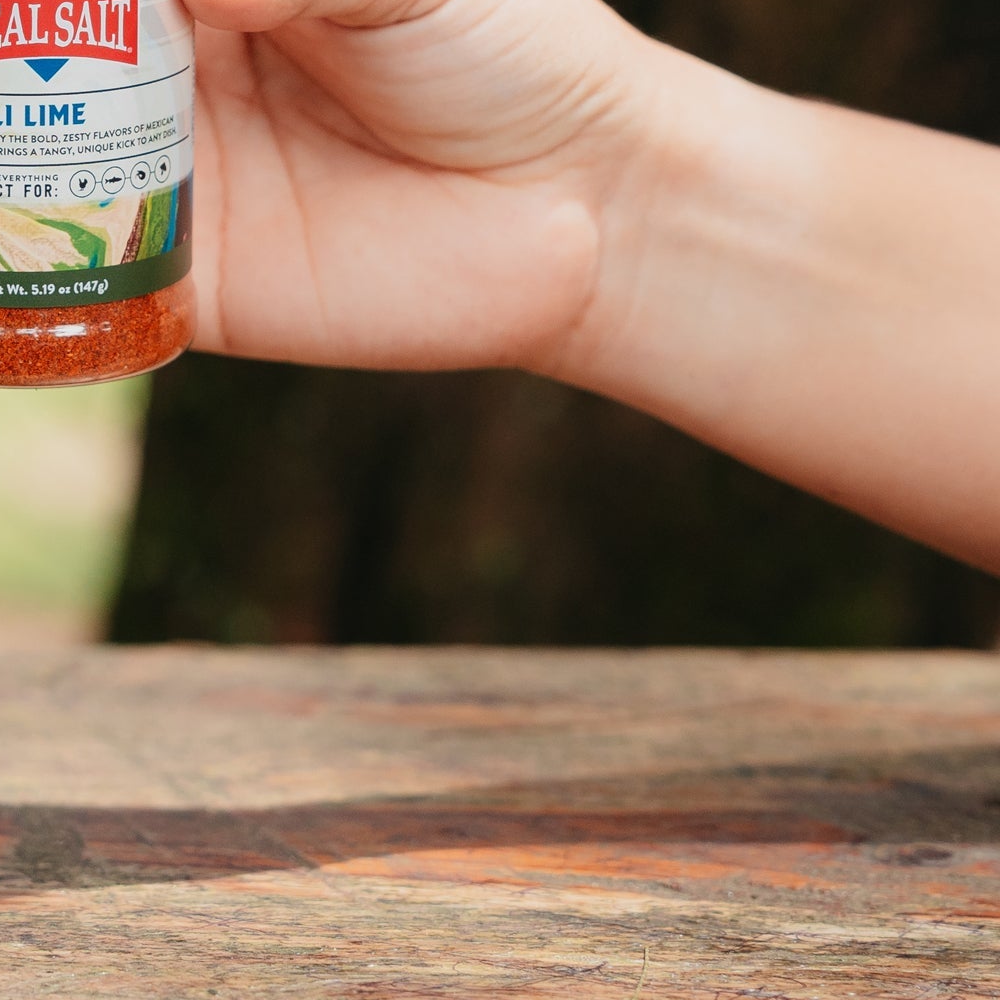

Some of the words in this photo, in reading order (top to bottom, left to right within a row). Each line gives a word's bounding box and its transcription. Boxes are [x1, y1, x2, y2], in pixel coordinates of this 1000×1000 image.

[24, 102, 86, 127] LIME
[9, 134, 28, 144] THE
[31, 134, 61, 144] BOLD,
[63, 132, 91, 142] ZESTY
[93, 126, 132, 140] FLAVORS
[133, 124, 145, 134] OF
[146, 115, 174, 131] MEXICAN
[30, 148, 38, 156] A
[40, 146, 75, 156] TANGY,
[77, 142, 114, 154] UNIQUE
[116, 138, 136, 149] KICK
[137, 136, 147, 145] TO
[148, 133, 161, 143] ANY
[24, 184, 59, 198] FOR:
[6, 284, 28, 295] Wt.
[31, 284, 55, 295] 5.19
[58, 286, 71, 294] oz
[73, 279, 109, 295] (147g)
